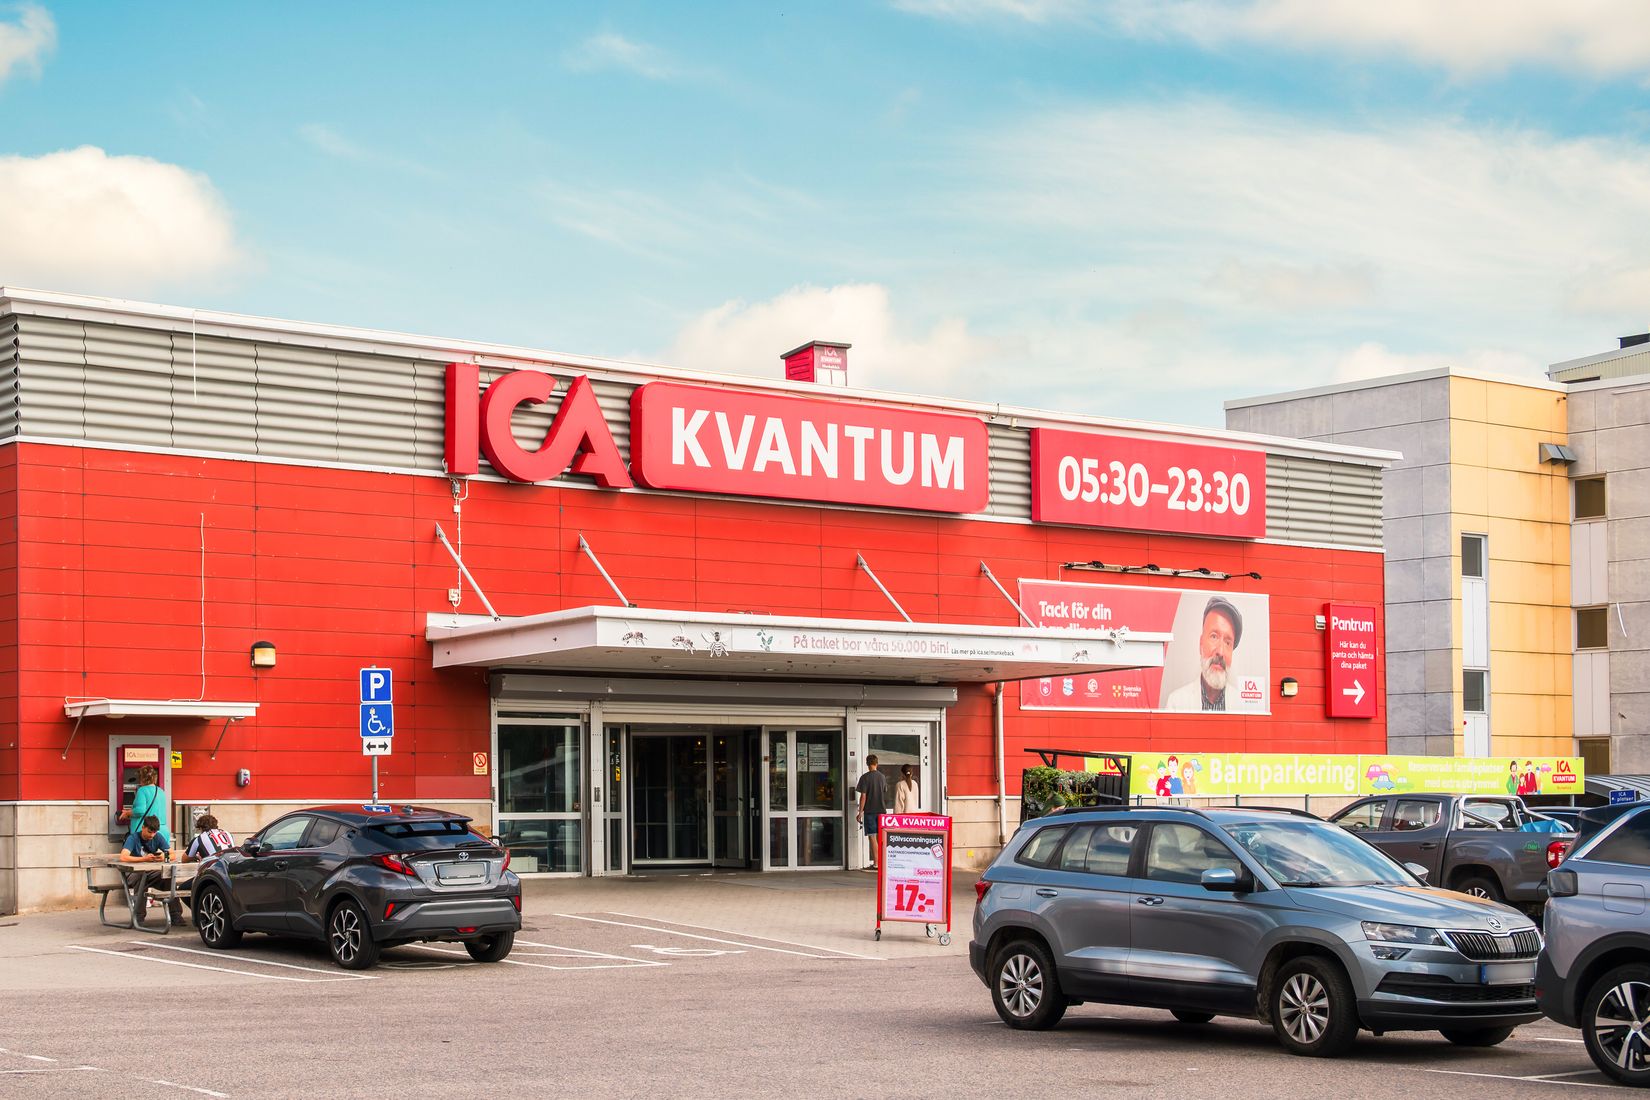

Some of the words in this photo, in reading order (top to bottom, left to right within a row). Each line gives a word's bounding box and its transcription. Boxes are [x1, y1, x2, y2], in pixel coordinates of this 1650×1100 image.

[445, 362, 633, 488] ICA
[671, 407, 965, 491] KVANTUM
[1039, 600, 1069, 618] Tack
[1071, 601, 1090, 620] för
[1092, 603, 1112, 621] din
[1331, 616, 1374, 632] Pantrum
[793, 634, 808, 648] På
[811, 636, 840, 650] taket
[842, 637, 862, 651] bor
[865, 637, 889, 652] våra
[891, 640, 927, 653] 50.000
[930, 641, 949, 654] bin!
[1340, 641, 1349, 649] Här
[1349, 641, 1359, 649] kan
[1359, 641, 1367, 650] du
[969, 648, 976, 657] på
[1332, 651, 1347, 660] panta
[1347, 651, 1358, 659] och
[1358, 651, 1374, 660] hämta
[1340, 661, 1352, 669] dina
[1352, 661, 1367, 671] paket
[370, 672, 385, 699] P
[1244, 680, 1258, 691] ICA
[1556, 760, 1571, 773] ICA
[1210, 757, 1356, 791] Barnparkering
[881, 816, 899, 827] ICA
[902, 818, 945, 827] KVANTUM
[210, 831, 232, 845] 10
